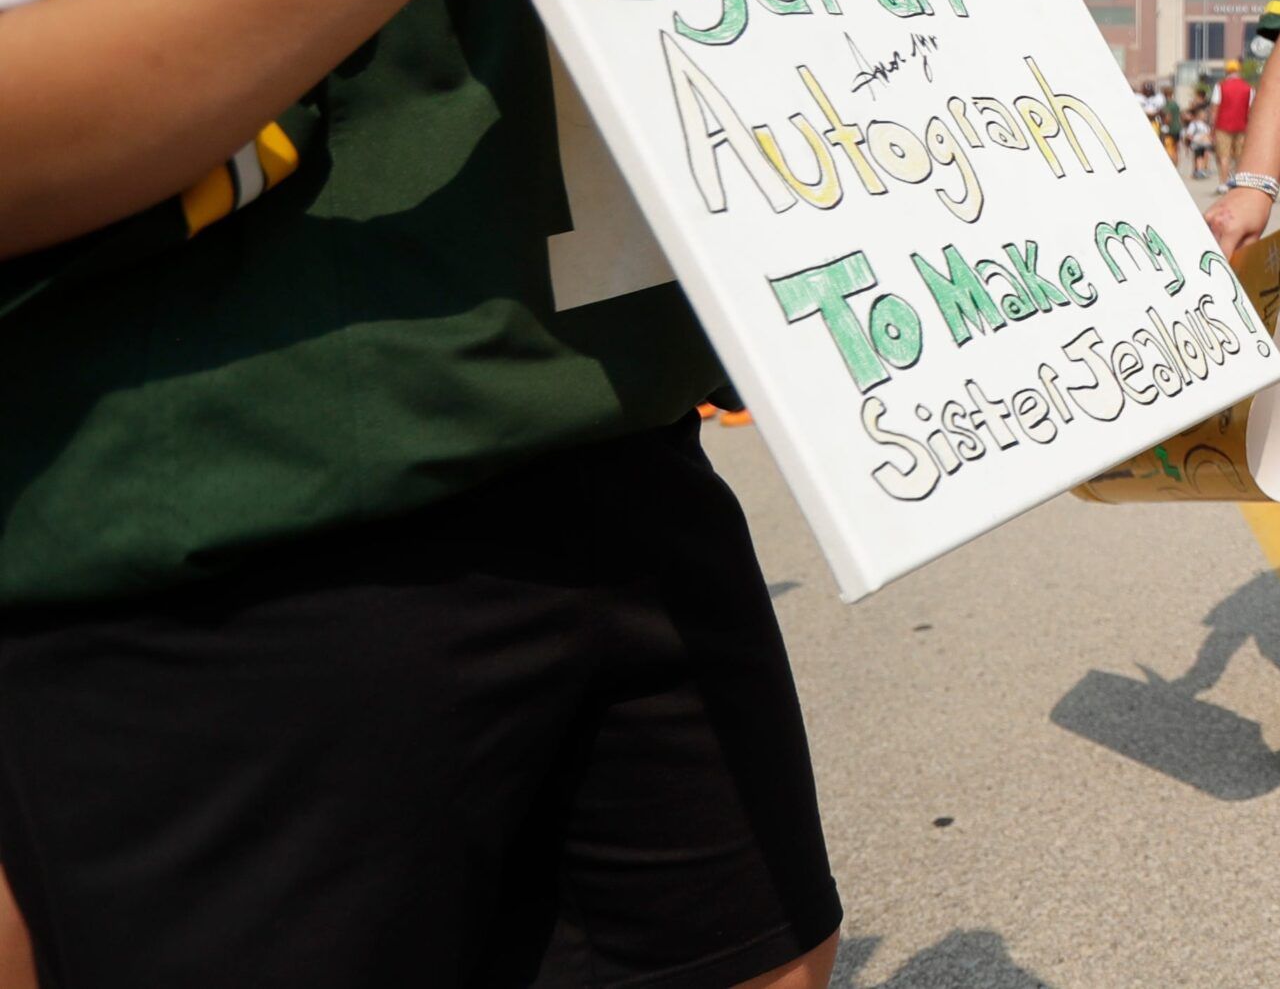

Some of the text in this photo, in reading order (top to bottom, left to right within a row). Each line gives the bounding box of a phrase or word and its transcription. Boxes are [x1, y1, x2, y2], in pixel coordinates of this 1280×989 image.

[660, 27, 1127, 224] Autograph
[769, 249, 924, 396] To
[911, 239, 1099, 348] Make
[861, 362, 1076, 502] Sister
